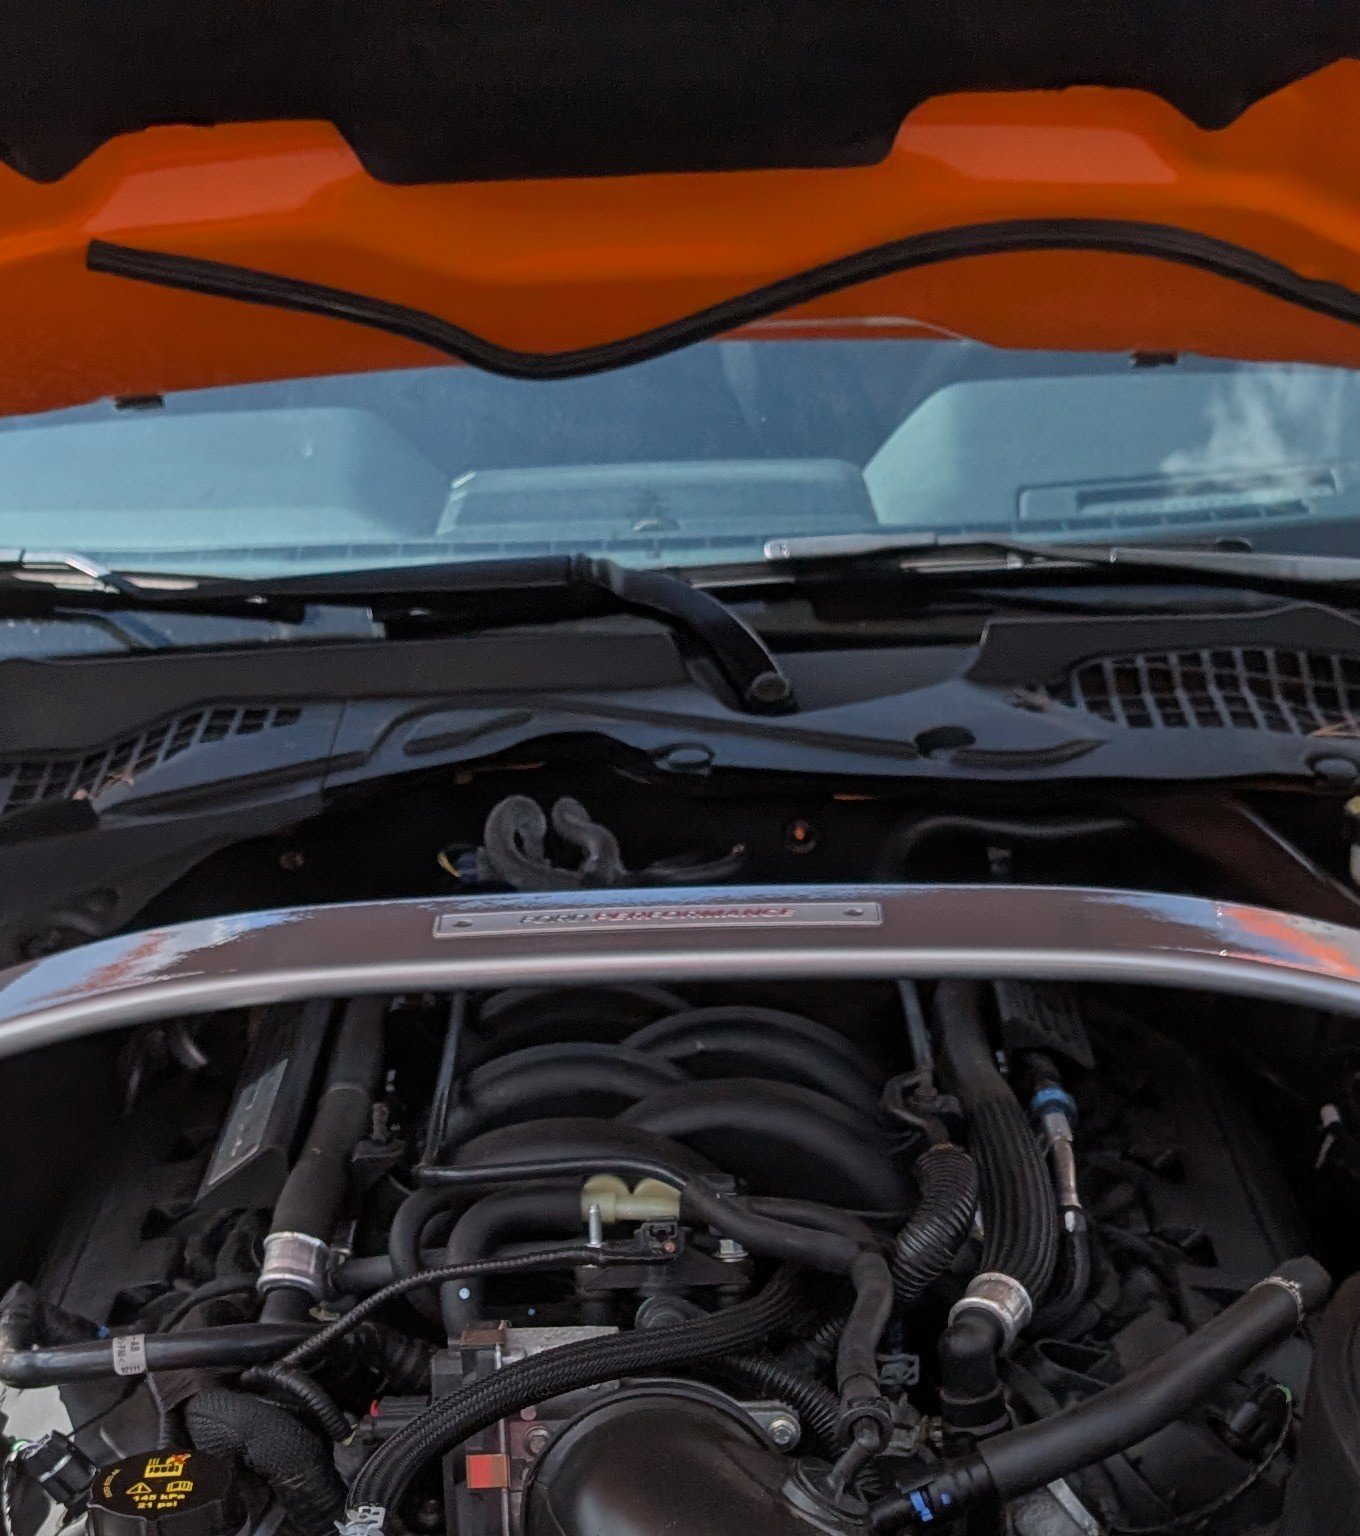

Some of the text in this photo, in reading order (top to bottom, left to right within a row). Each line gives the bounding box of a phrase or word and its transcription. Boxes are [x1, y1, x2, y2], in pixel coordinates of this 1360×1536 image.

[519, 905, 796, 926] FORD PERFORMANCE
[160, 1493, 186, 1501] kPa
[157, 1501, 178, 1510] psi
